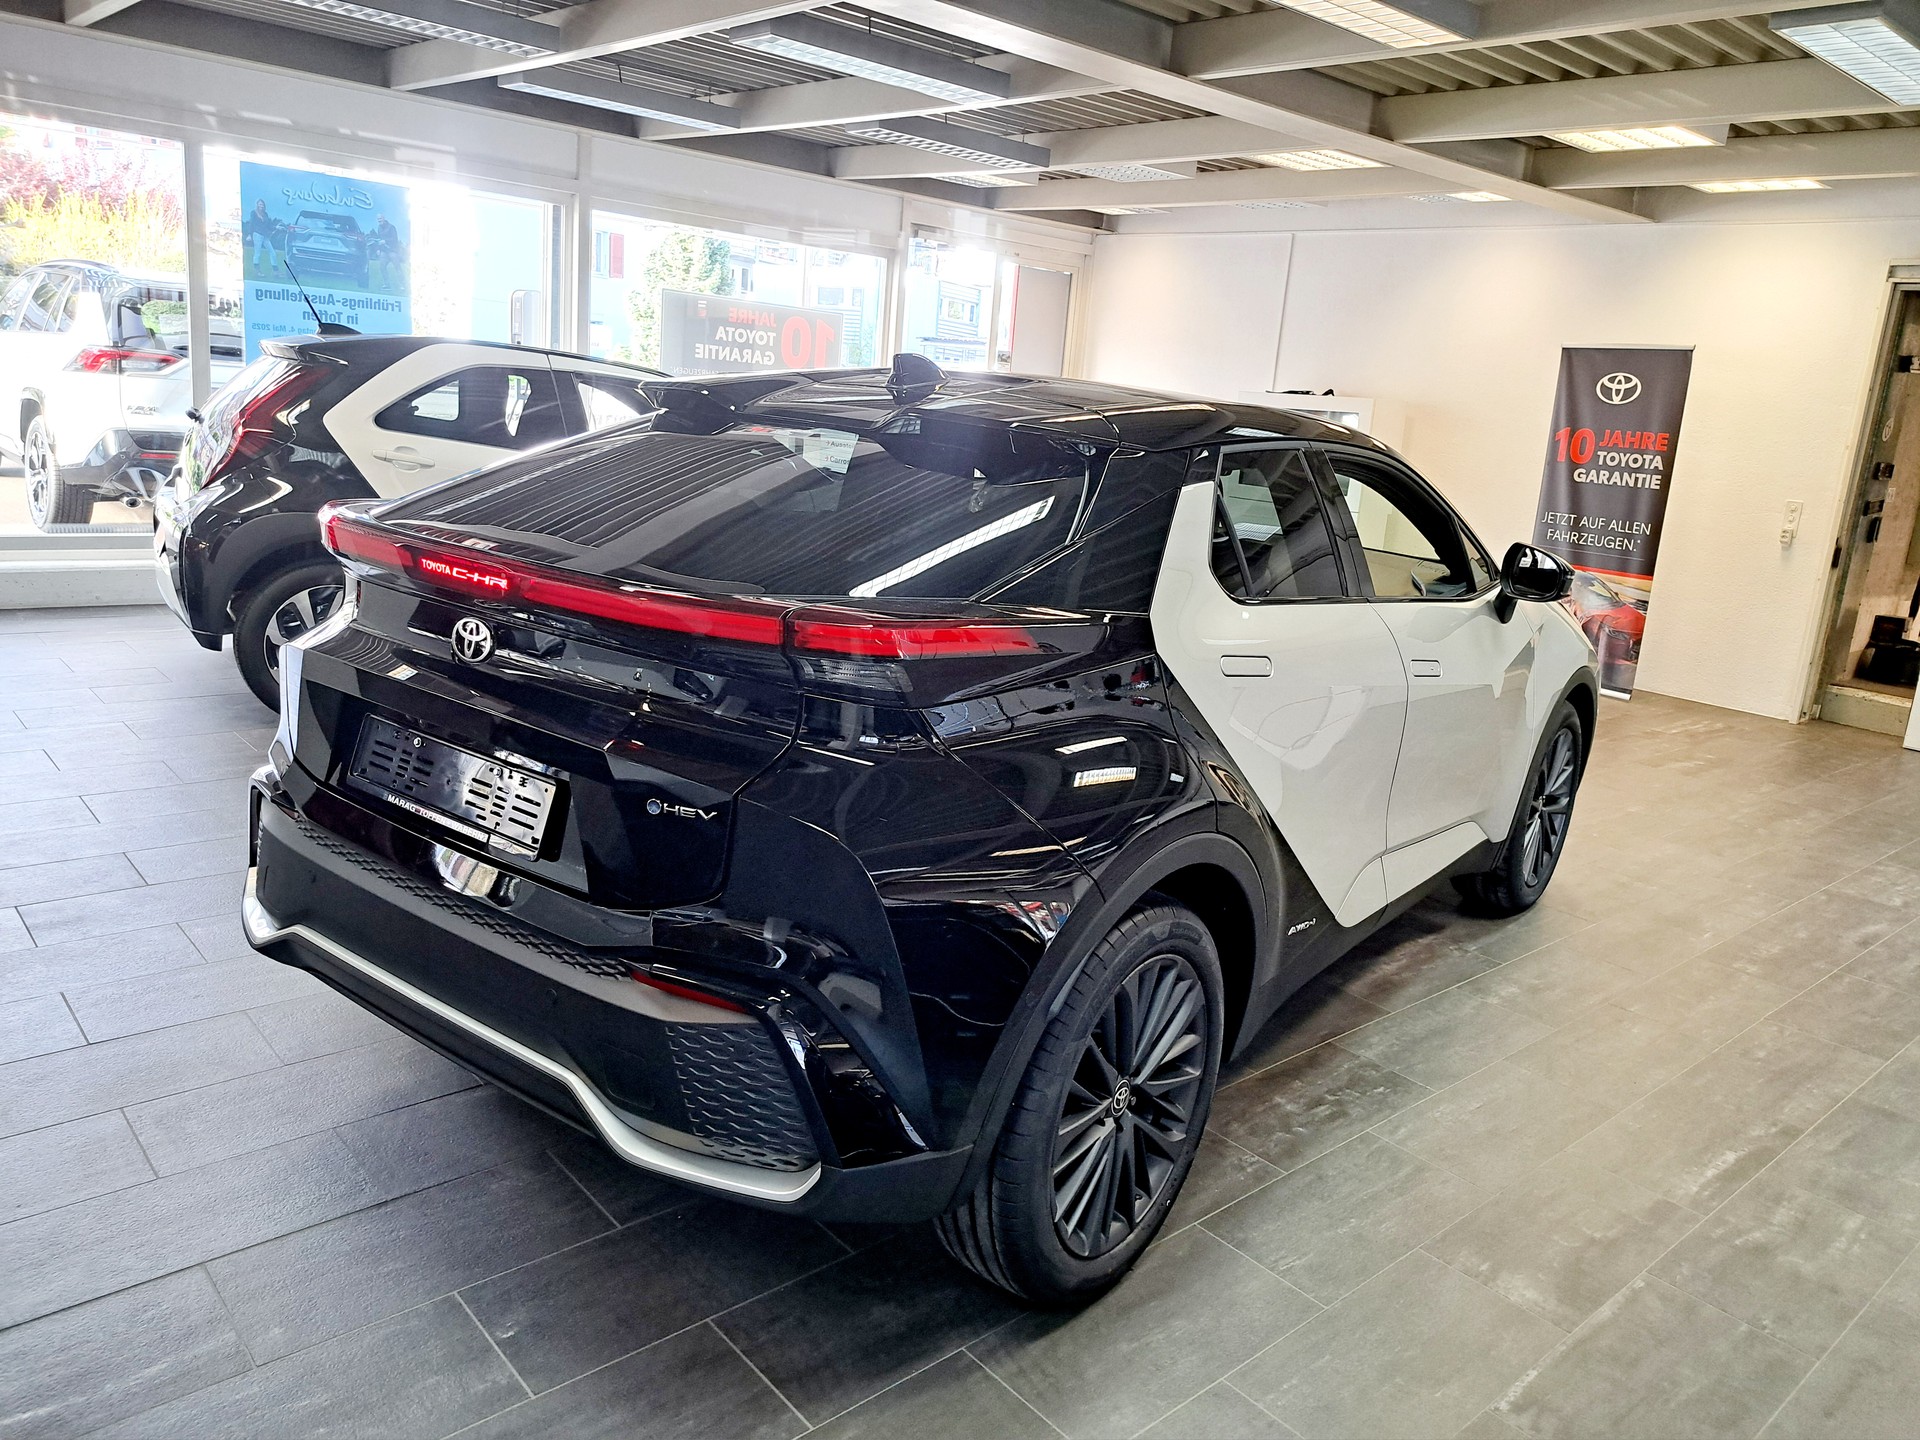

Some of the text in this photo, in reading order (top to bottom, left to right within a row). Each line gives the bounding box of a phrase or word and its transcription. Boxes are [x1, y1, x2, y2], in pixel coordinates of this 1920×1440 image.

[1555, 426, 1670, 465] 10 JAHRE
[1597, 450, 1664, 471] TOYOTA
[1573, 468, 1662, 490] GARANTIE
[1541, 511, 1652, 536] JETZT AUF ALLEN
[421, 558, 508, 590] TOYOTA C-HR
[387, 794, 416, 812] MARAG
[663, 802, 718, 821] HEV
